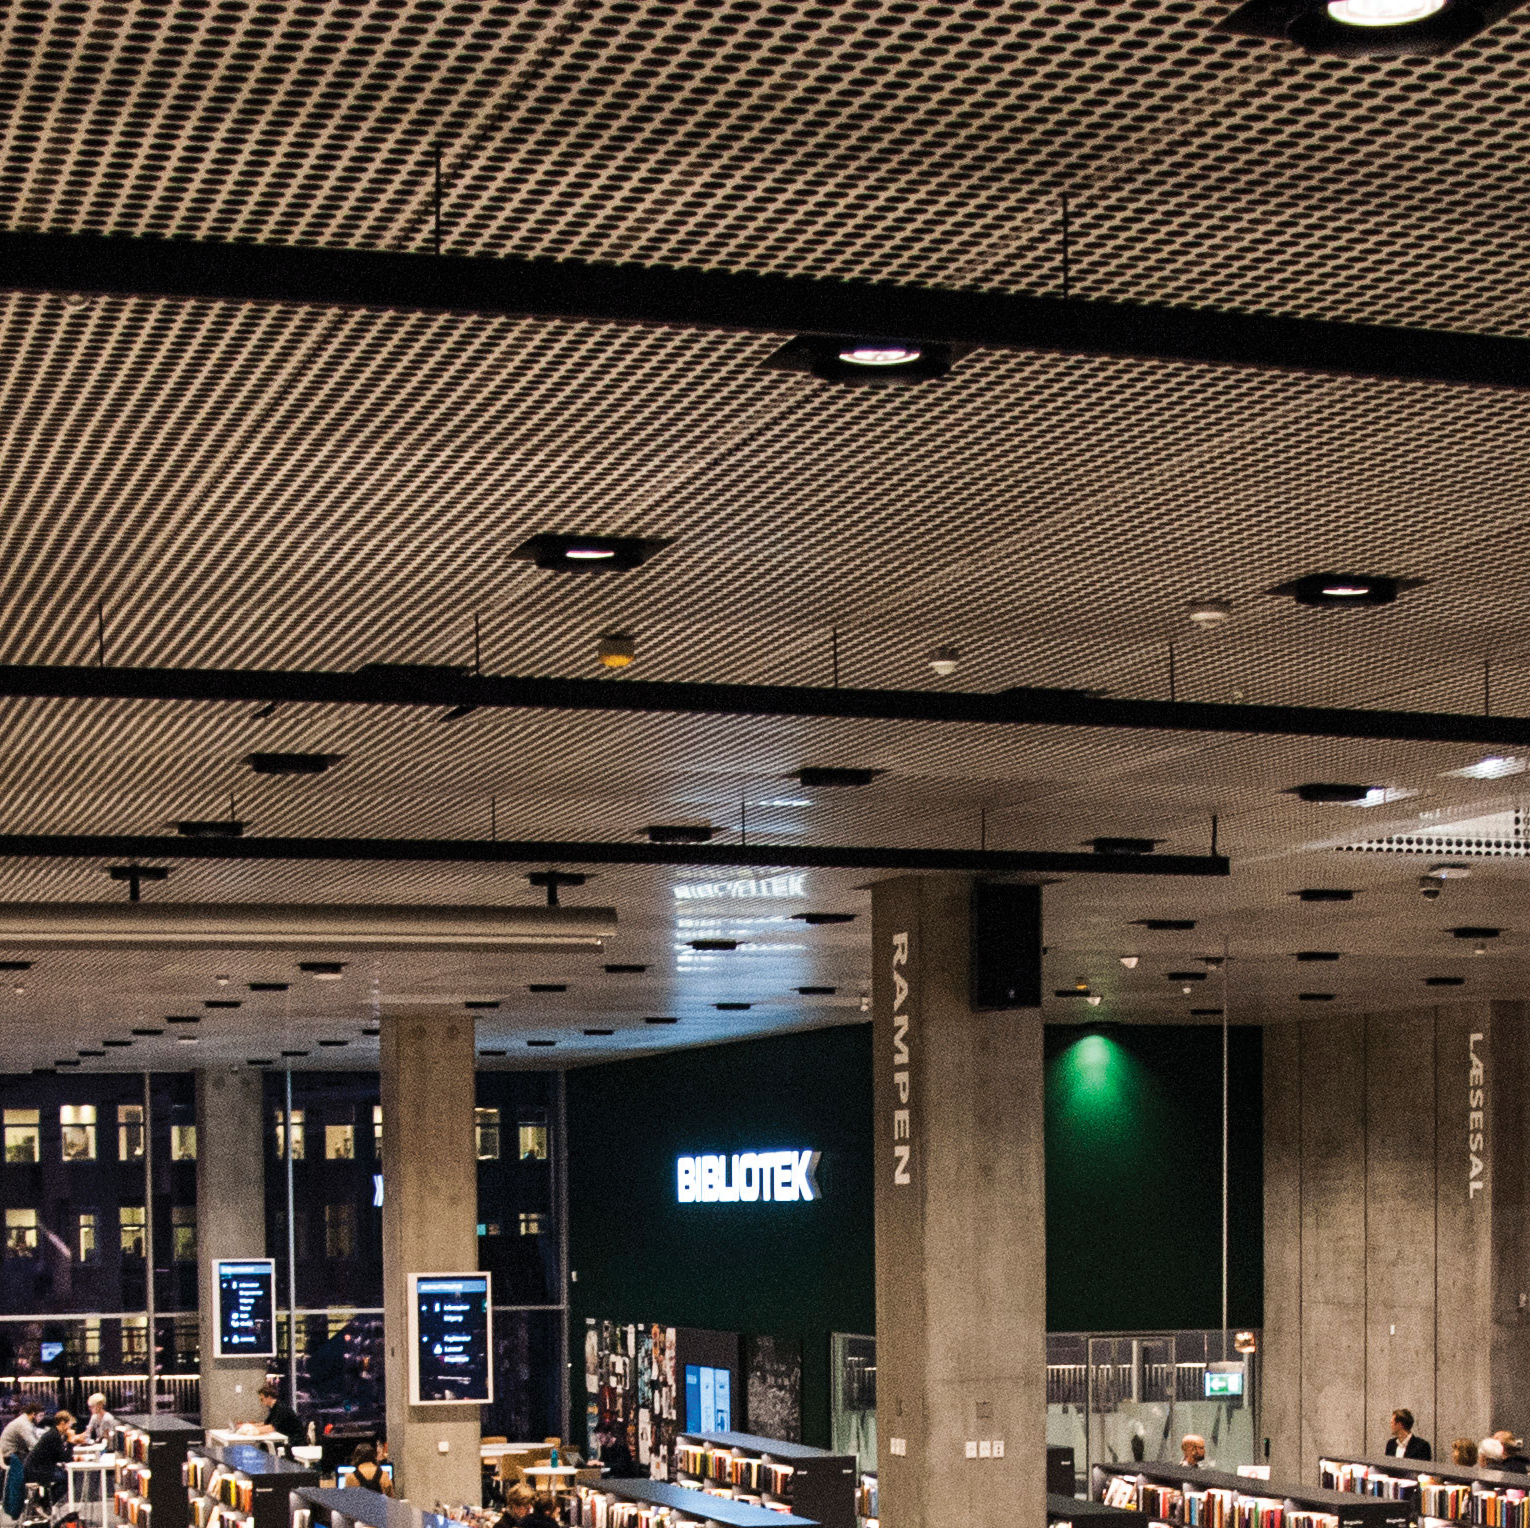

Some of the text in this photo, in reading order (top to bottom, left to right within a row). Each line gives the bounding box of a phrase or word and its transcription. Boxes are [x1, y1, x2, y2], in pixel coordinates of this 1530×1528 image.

[892, 931, 911, 1185] RAMPEN
[1469, 1032, 1484, 1199] LÆSESAL
[676, 1150, 816, 1202] BIBLIOTEK
